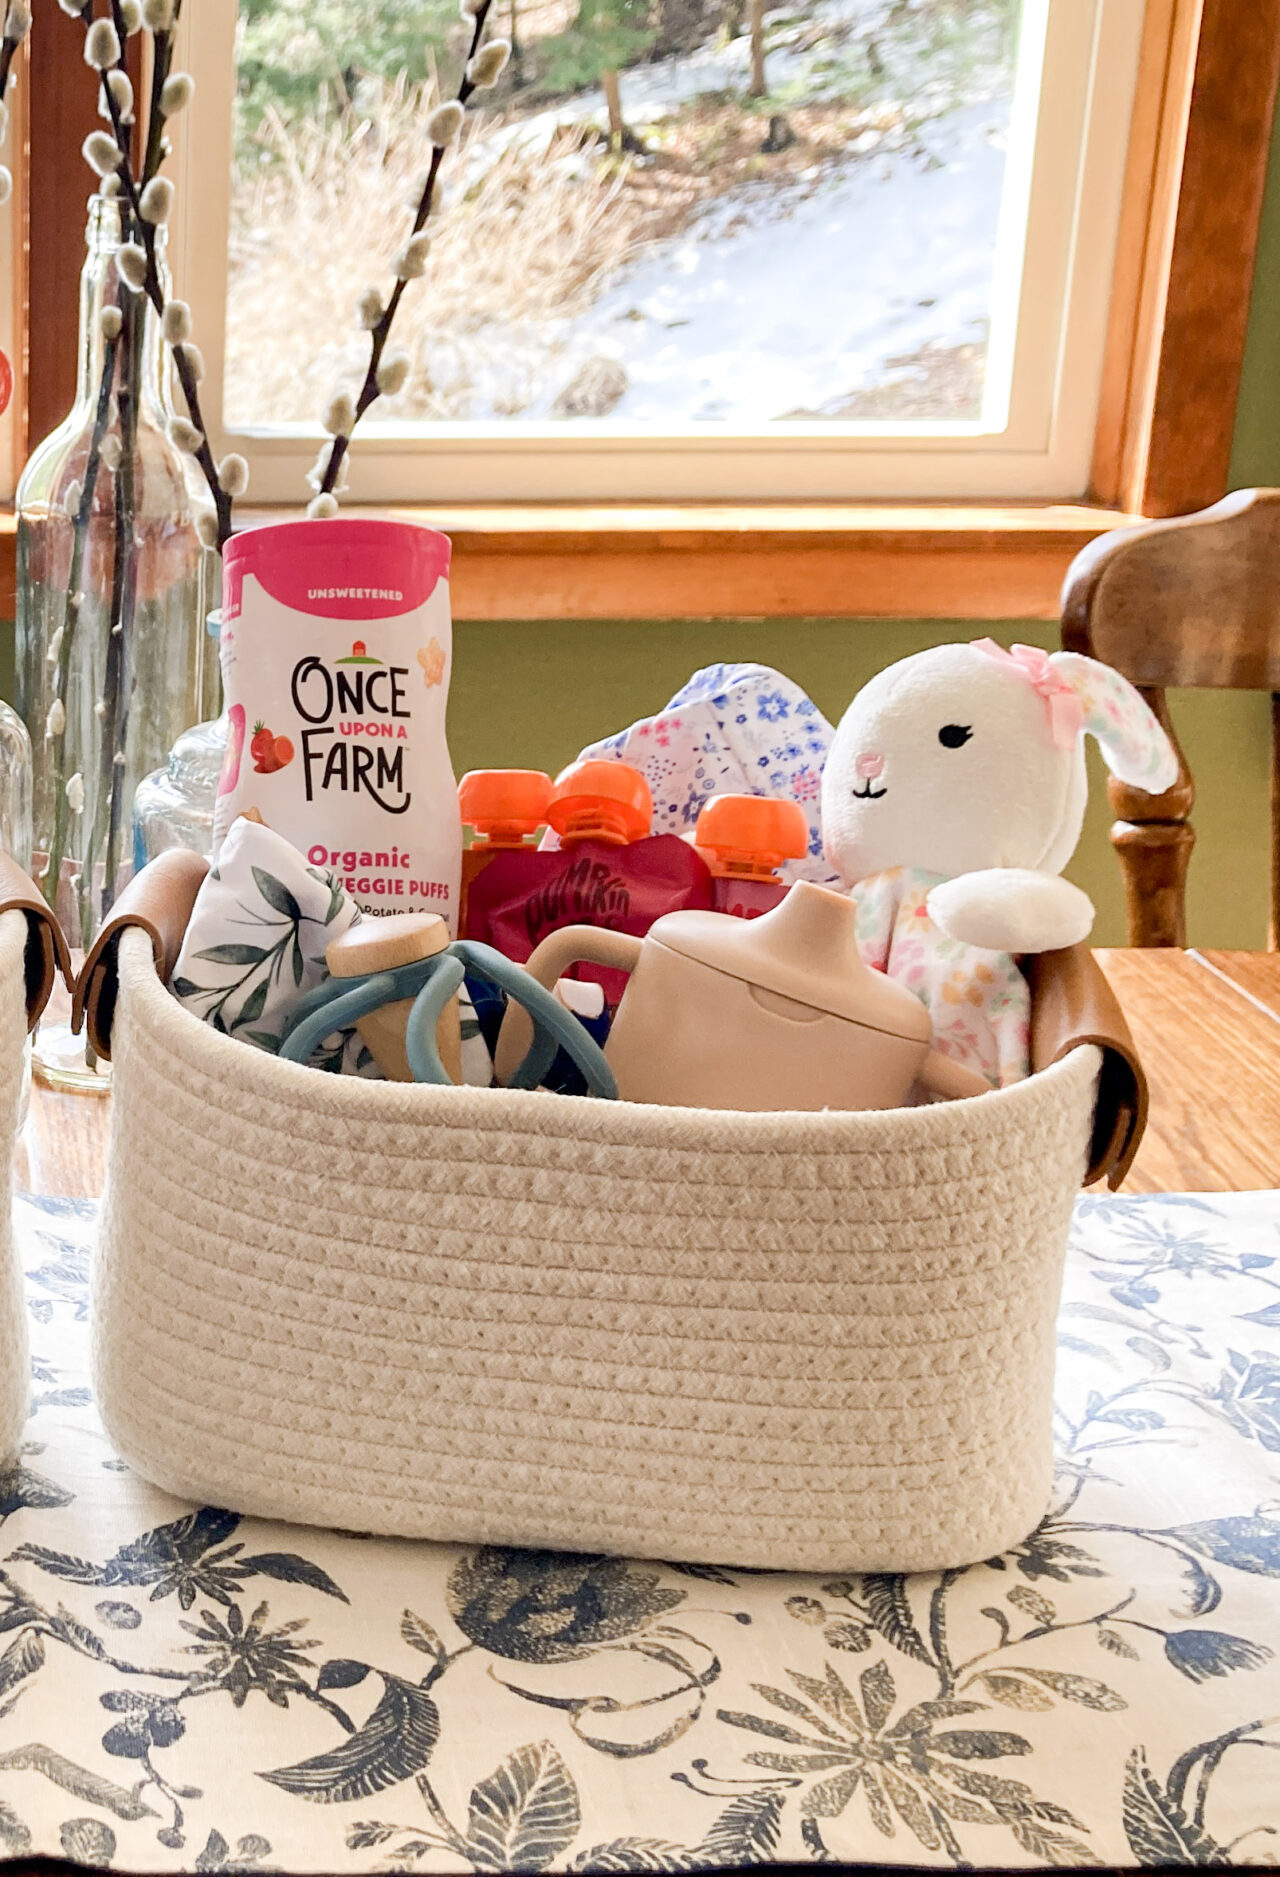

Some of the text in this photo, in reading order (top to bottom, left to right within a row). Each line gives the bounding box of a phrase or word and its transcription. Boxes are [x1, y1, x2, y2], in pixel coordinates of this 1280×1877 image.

[308, 588, 403, 601] UNSWEETENED
[291, 656, 411, 724] ONCE
[339, 722, 408, 739] UPON A
[301, 727, 411, 814] FARM
[308, 845, 410, 873] Organic
[338, 878, 449, 900] EGGIE PUFFS
